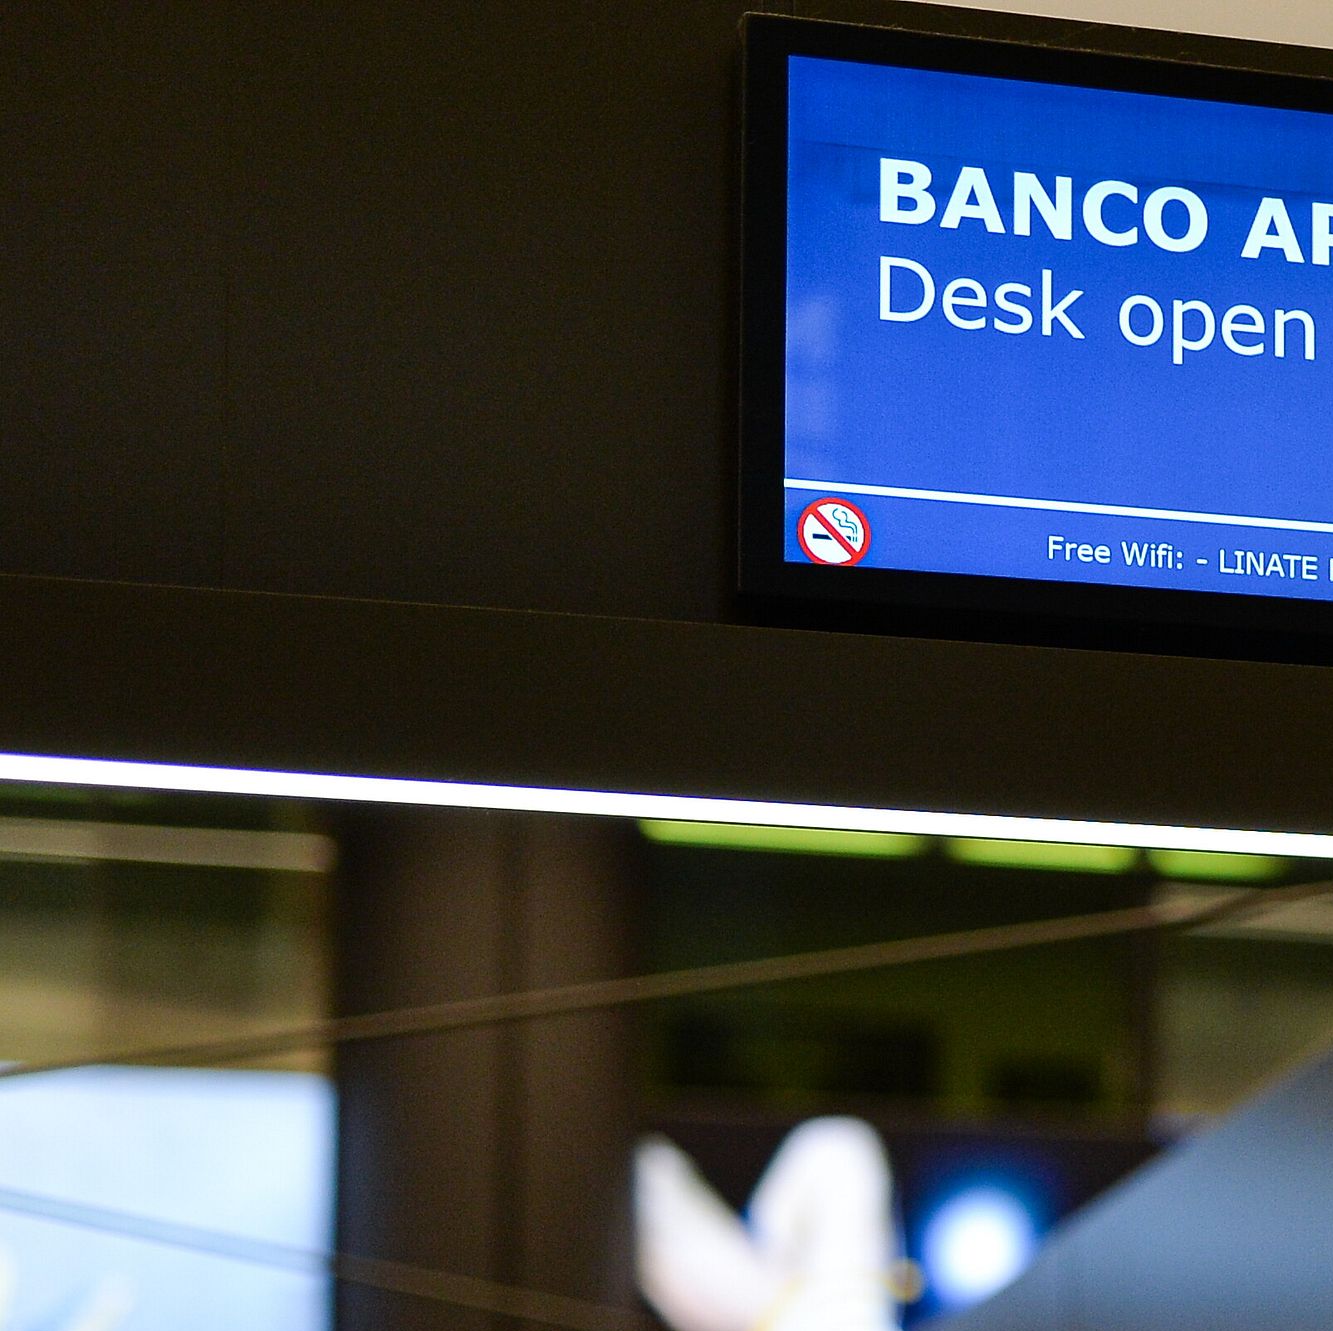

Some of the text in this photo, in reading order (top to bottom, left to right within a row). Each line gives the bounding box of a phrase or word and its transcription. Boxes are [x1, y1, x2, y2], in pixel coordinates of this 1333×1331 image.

[878, 156, 1209, 253] BANCO
[878, 255, 1317, 364] Desk open
[1047, 535, 1111, 565] Free
[1121, 541, 1183, 570] Wifi:
[1219, 549, 1318, 581] LINATE
